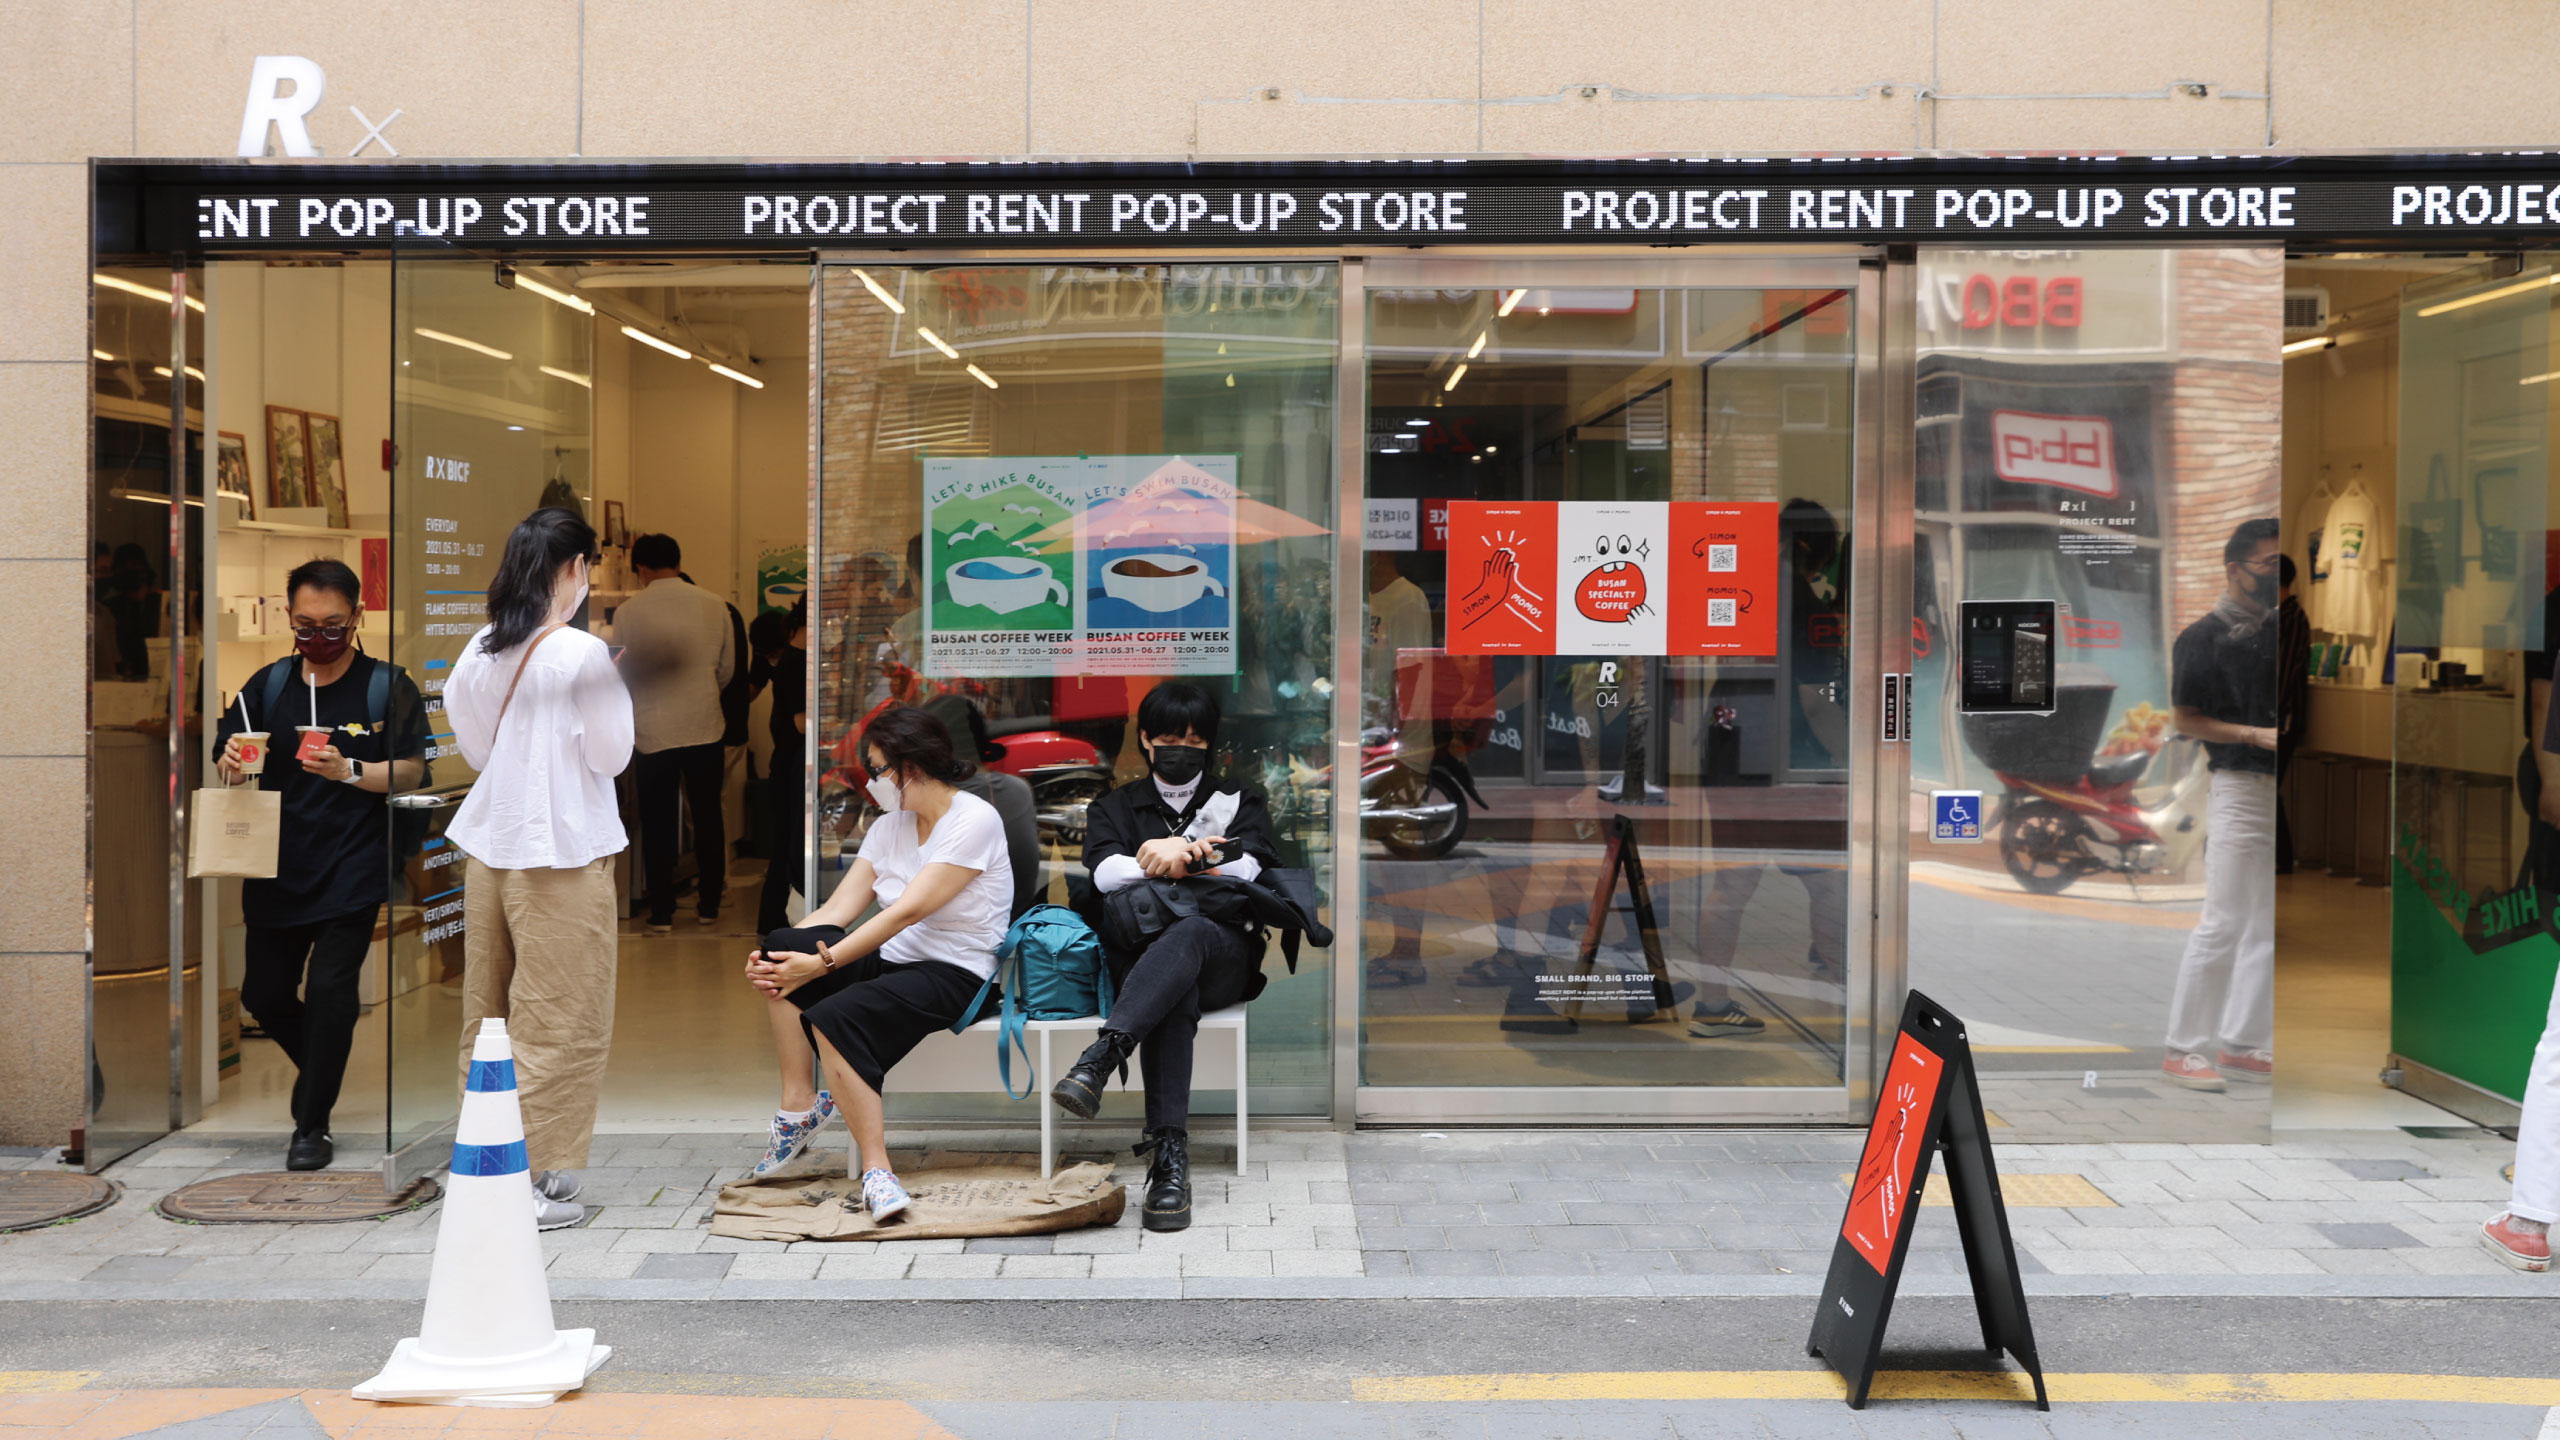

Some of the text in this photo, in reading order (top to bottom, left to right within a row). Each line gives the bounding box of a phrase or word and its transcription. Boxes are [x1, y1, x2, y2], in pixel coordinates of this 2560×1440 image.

[239, 56, 326, 156] R
[744, 192, 1467, 234] PROJECT RENT POP-UP STORE
[1562, 186, 2296, 230] PROJECT RENT POP-UP STORE
[300, 198, 482, 237] POP-UP
[503, 197, 650, 236] STORE
[931, 472, 1076, 507] LET'S HIKE BUSAN
[1085, 475, 1232, 500] LET'S SWIM BUSAN
[425, 517, 459, 533] EVERYDAY
[2059, 518, 2136, 526] PROJECT RENT
[1598, 579, 1627, 587] BUSAN
[1588, 590, 1636, 599] SPECIALTY
[425, 603, 488, 615] FLAME COFFEE ROAST
[1463, 593, 1491, 616] SIMON
[1511, 593, 1542, 618] MOMOS
[1595, 601, 1629, 610] COFFEE
[931, 633, 1073, 644] BUSAN COFFEE WEEK
[1087, 632, 1229, 642] BUSAN COFFEE WEEK
[932, 648, 978, 656] 2021.05.31
[1599, 662, 1617, 683] R
[1596, 692, 1619, 708] 04
[1534, 975, 1565, 983] SMALL
[1568, 975, 1602, 983] BRAND,
[1625, 974, 1656, 982] STORY
[2083, 1071, 2098, 1088] R
